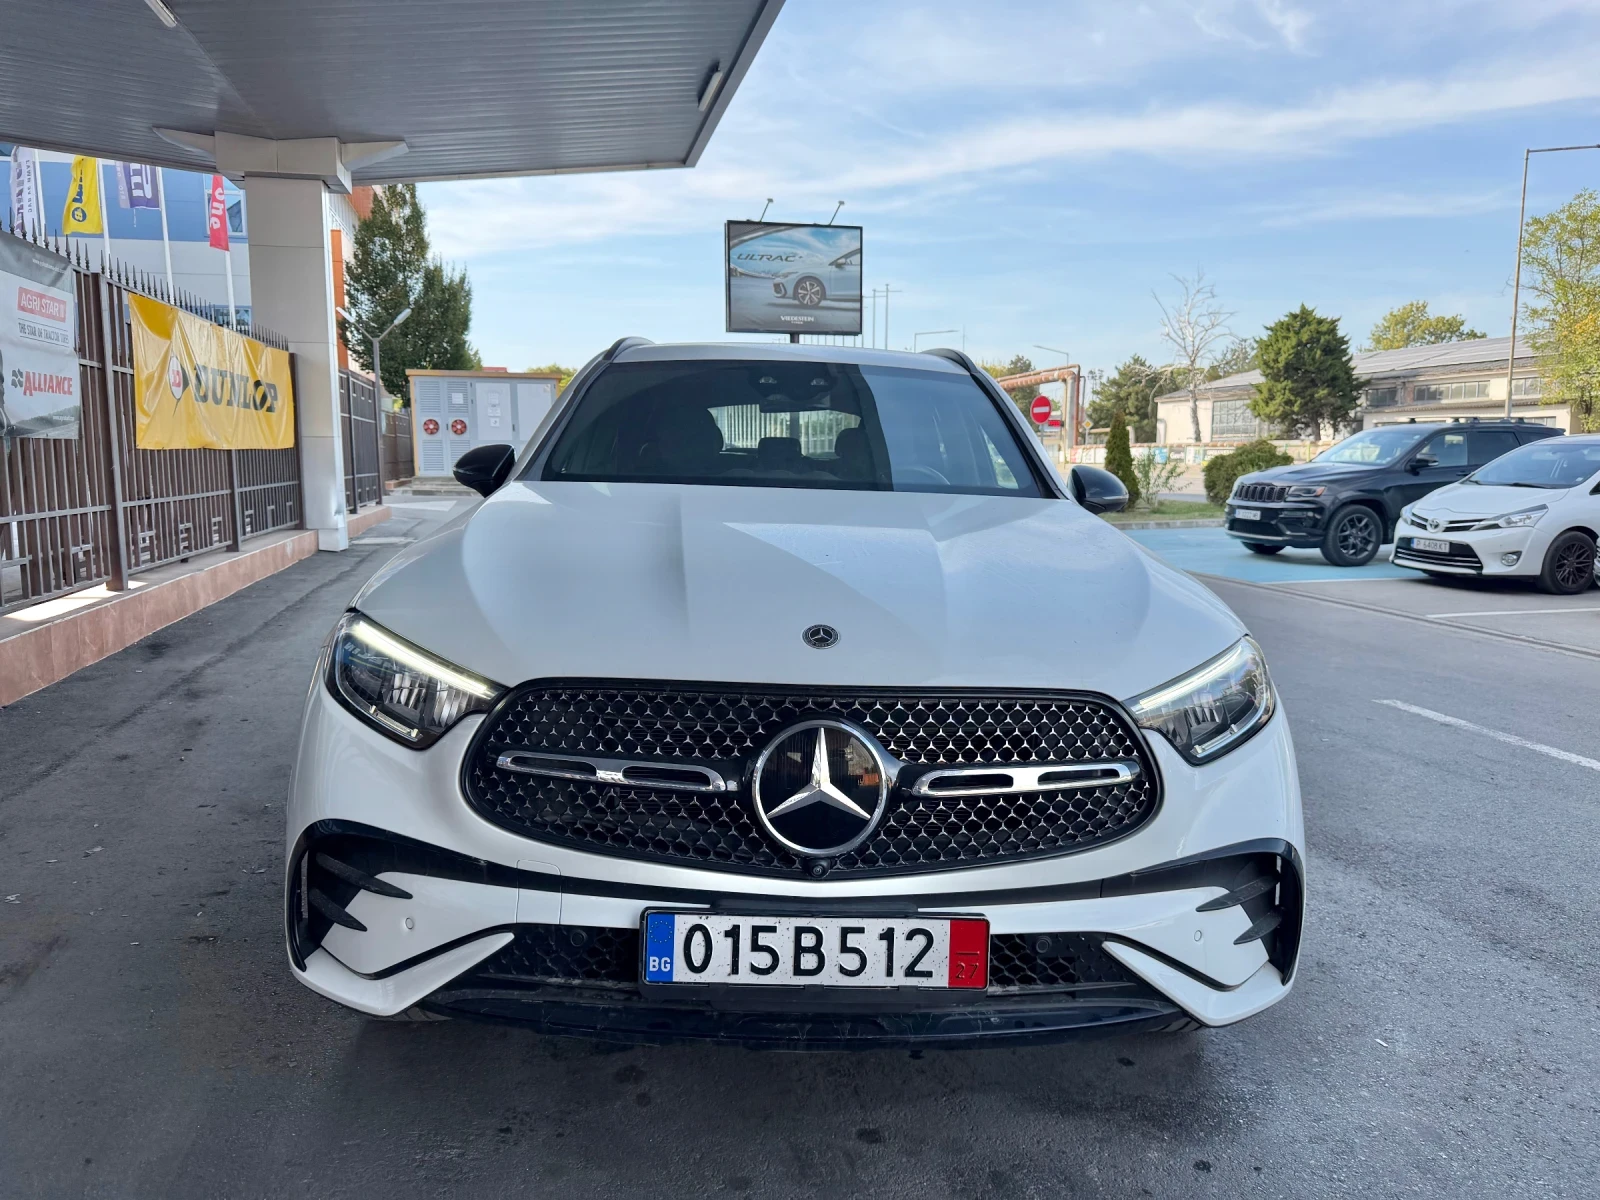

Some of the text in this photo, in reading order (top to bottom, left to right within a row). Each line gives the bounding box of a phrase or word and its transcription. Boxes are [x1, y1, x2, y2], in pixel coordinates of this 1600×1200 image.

[20, 292, 40, 311] AGRI
[41, 299, 59, 317] STAR
[18, 322, 27, 335] THE
[27, 325, 37, 337] STAR
[23, 371, 73, 397] ALLIANCE
[194, 363, 278, 413] DUNLOP
[683, 923, 935, 979] 015B512
[649, 956, 671, 972] BG
[956, 961, 979, 979] 27
